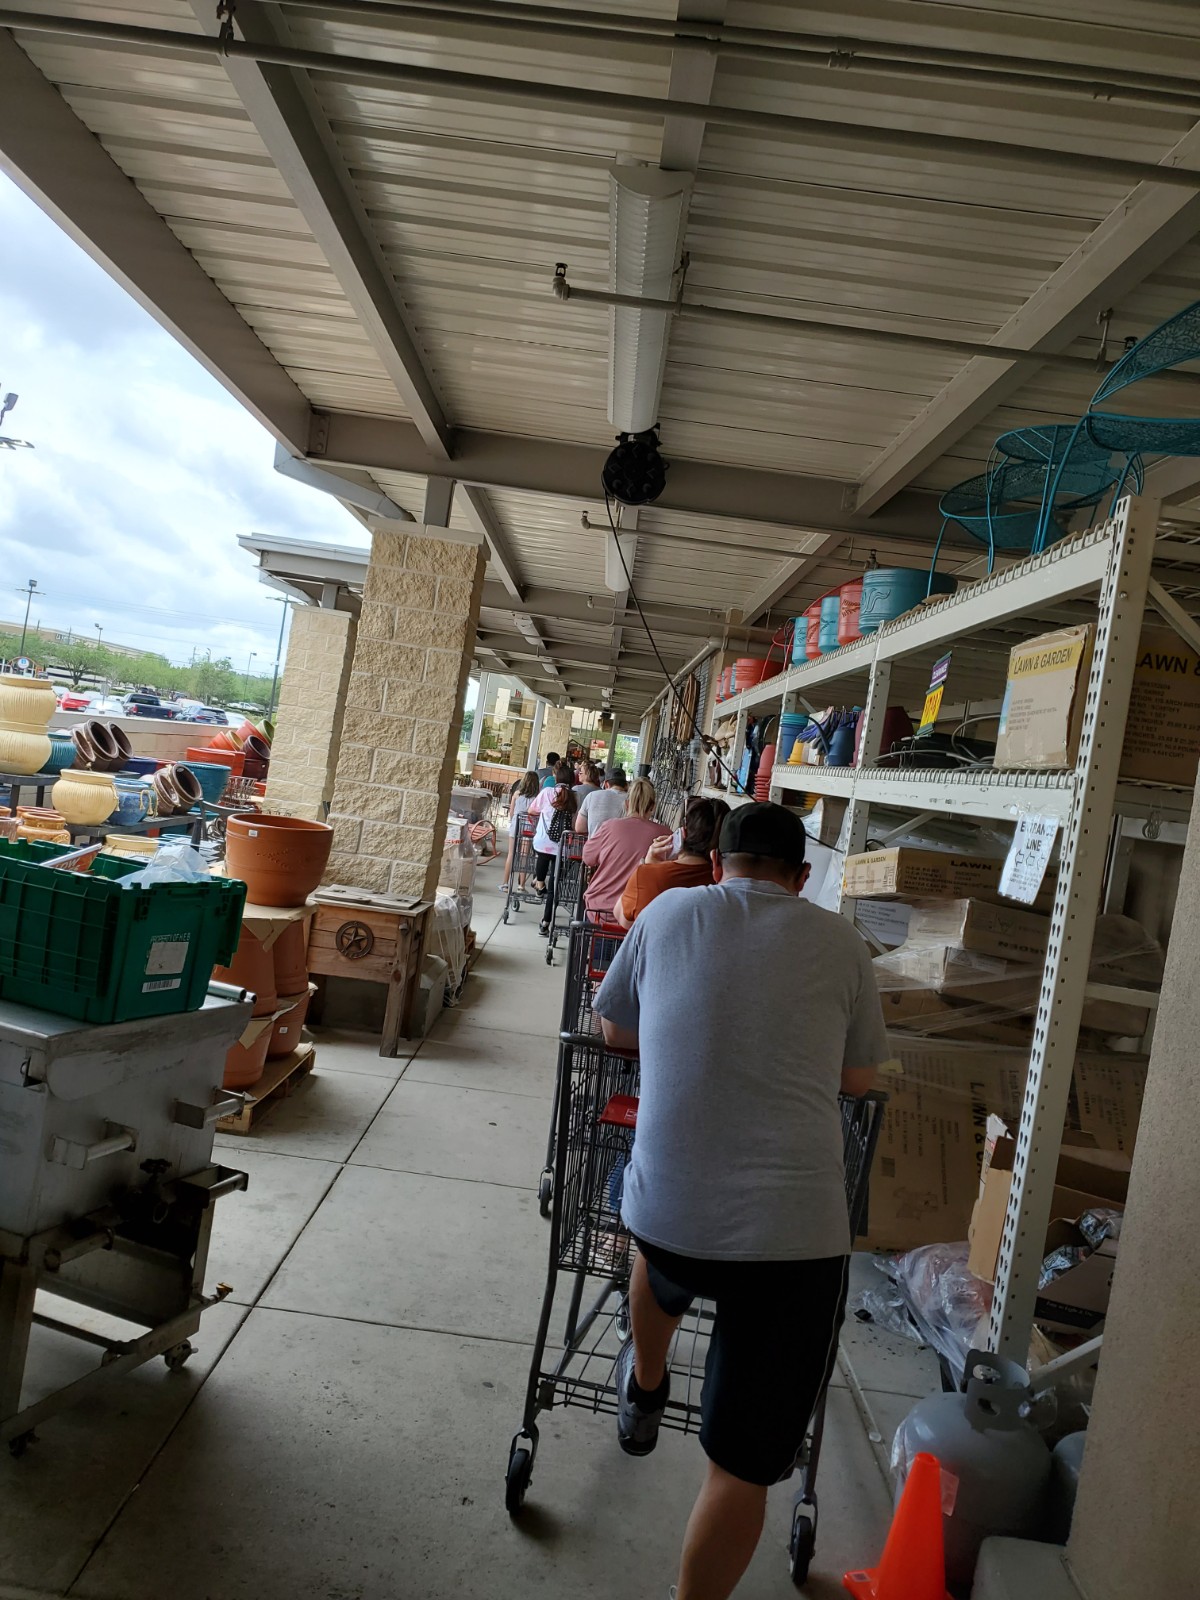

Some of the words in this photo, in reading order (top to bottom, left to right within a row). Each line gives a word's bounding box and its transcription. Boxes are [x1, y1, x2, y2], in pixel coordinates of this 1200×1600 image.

[1013, 655, 1034, 675] LAWN
[1040, 647, 1073, 669] GARDEN
[1135, 652, 1188, 675] AWN
[1020, 821, 1055, 837] ETRANCE
[1026, 839, 1042, 852] LINE
[950, 860, 992, 871] LAWN
